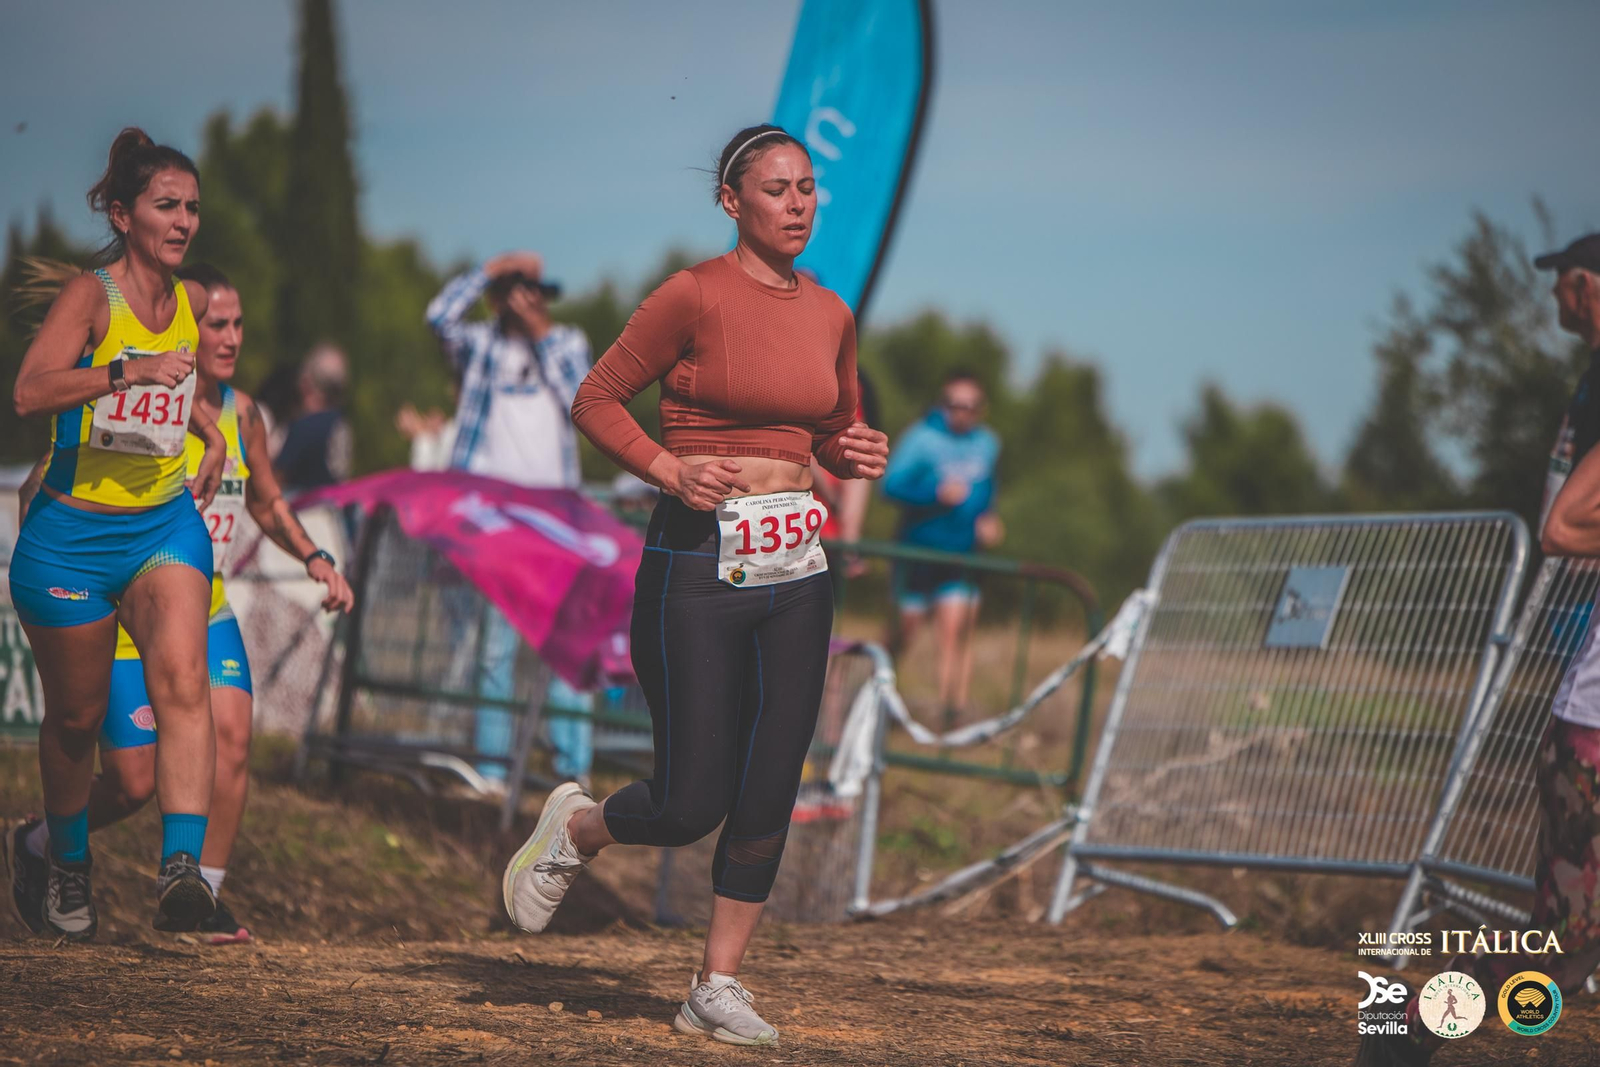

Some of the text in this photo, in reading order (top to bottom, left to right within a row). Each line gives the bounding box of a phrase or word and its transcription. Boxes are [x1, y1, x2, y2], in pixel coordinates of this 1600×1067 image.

[108, 390, 186, 426] 1431
[745, 498, 771, 506] CAROLINA
[201, 512, 234, 542] 22
[735, 508, 822, 555] 1359
